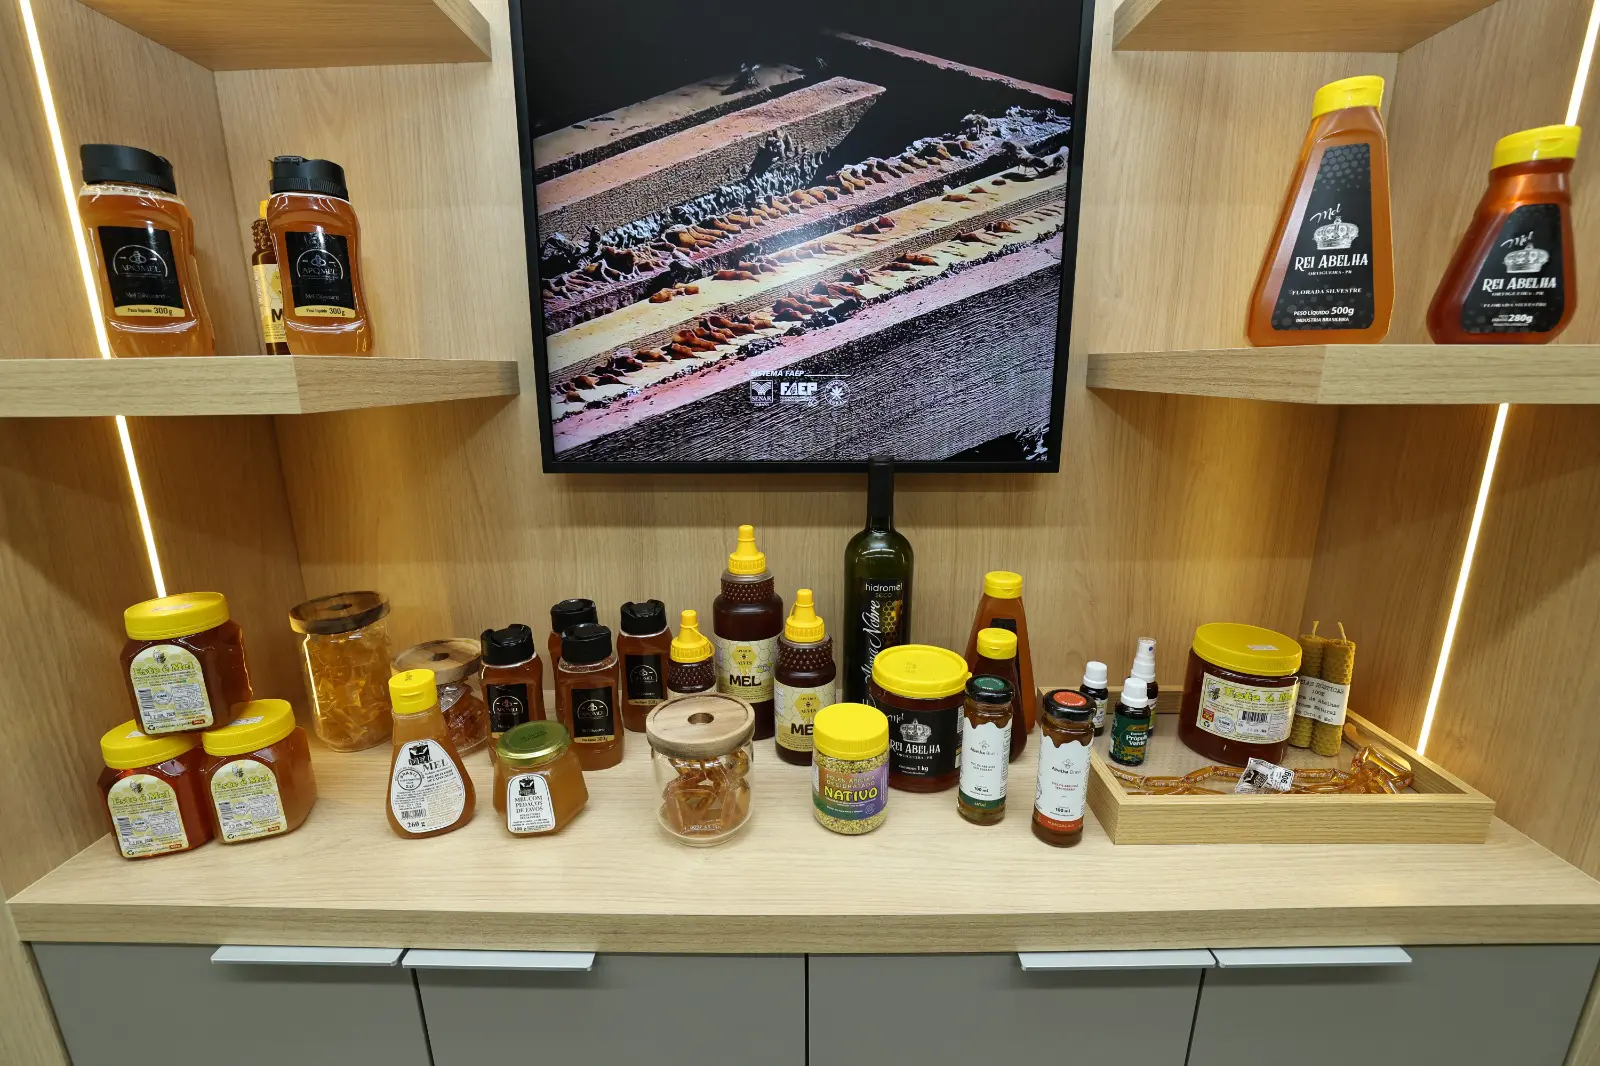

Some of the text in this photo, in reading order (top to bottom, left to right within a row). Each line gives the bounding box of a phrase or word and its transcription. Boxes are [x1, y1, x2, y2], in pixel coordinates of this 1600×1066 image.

[1309, 203, 1341, 224] Mel
[1294, 253, 1369, 272] REI ABELHA
[1482, 277, 1557, 292] REI ABELHA
[1291, 288, 1325, 296] FLORADA
[1330, 306, 1355, 317] 500g
[1507, 314, 1534, 324] 280g
[780, 381, 818, 396] FAEP
[865, 582, 903, 592] hidromel
[862, 600, 882, 649] Nobre
[729, 675, 762, 687] MEL
[1300, 679, 1315, 687] ELAS
[790, 723, 814, 736] ME
[890, 739, 941, 755] REI ABELHA
[422, 758, 449, 772] MEL
[824, 785, 878, 802] NATIVO
